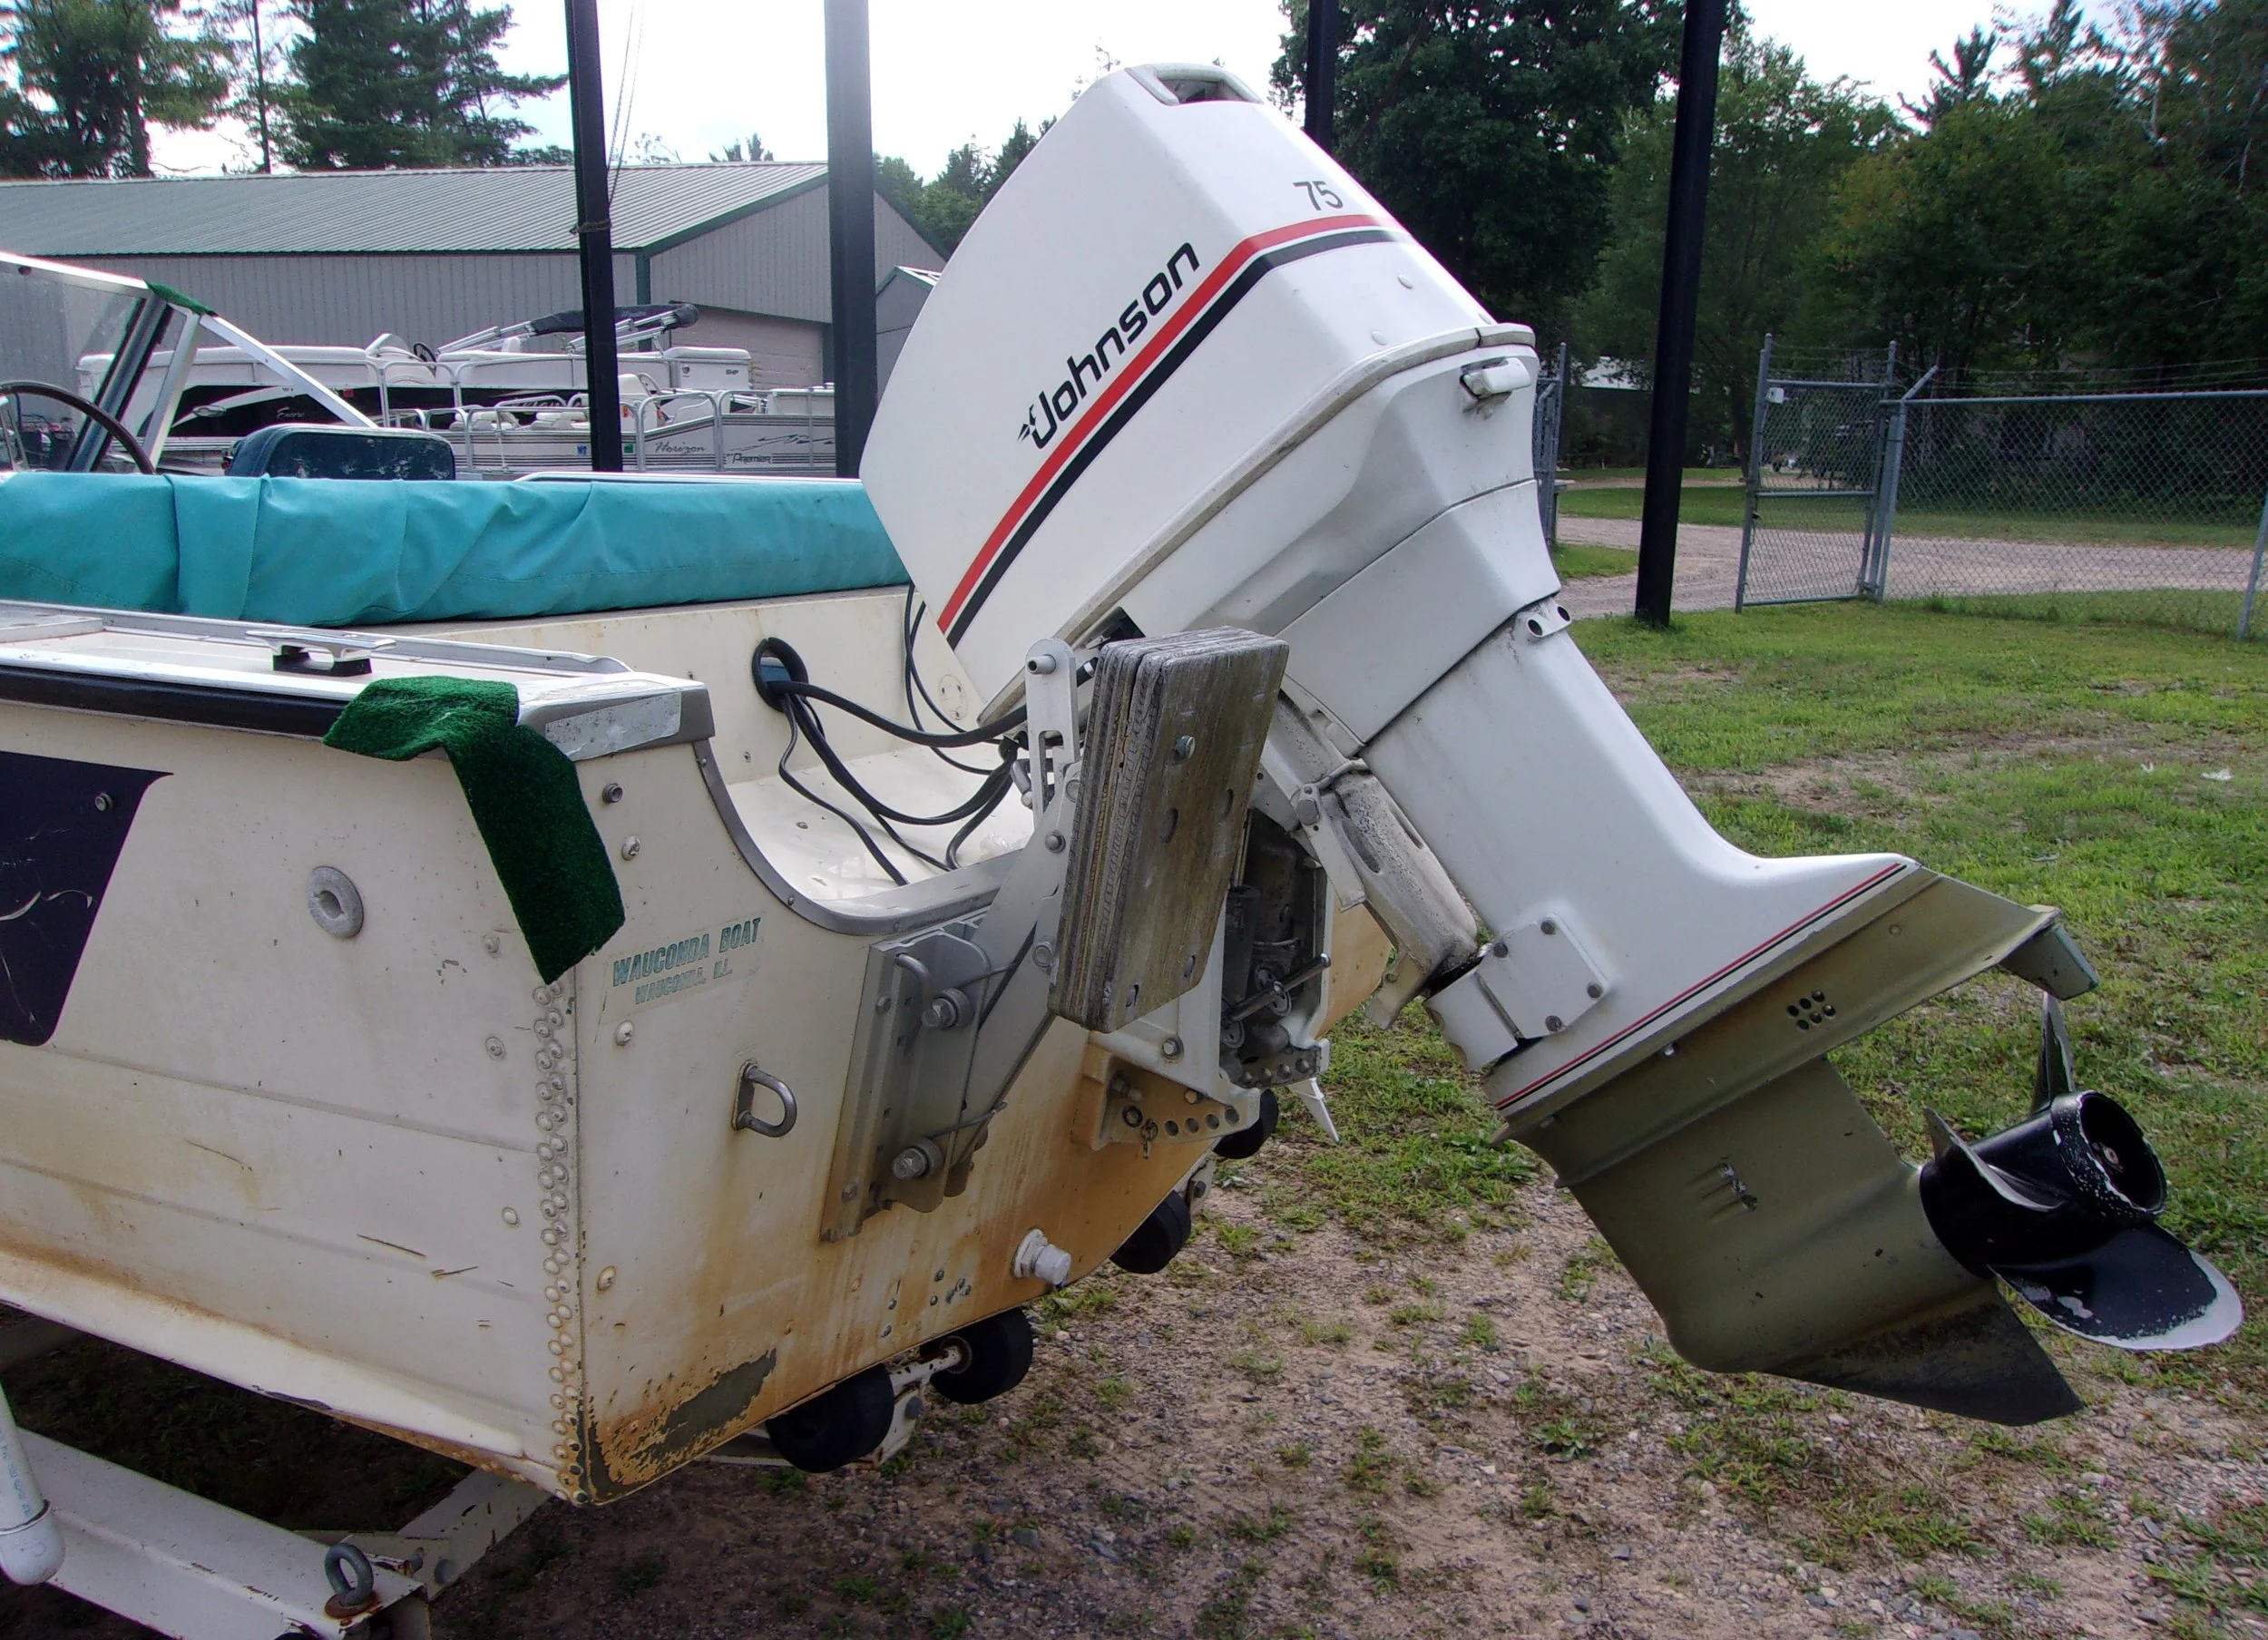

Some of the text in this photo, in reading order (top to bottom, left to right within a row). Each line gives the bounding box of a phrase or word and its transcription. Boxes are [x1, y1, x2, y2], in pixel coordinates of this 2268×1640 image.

[1292, 181, 1344, 211] 75
[1030, 242, 1200, 450] Johnson
[655, 441, 705, 454] Horizon
[612, 917, 761, 987] WAUCONDA BOAT
